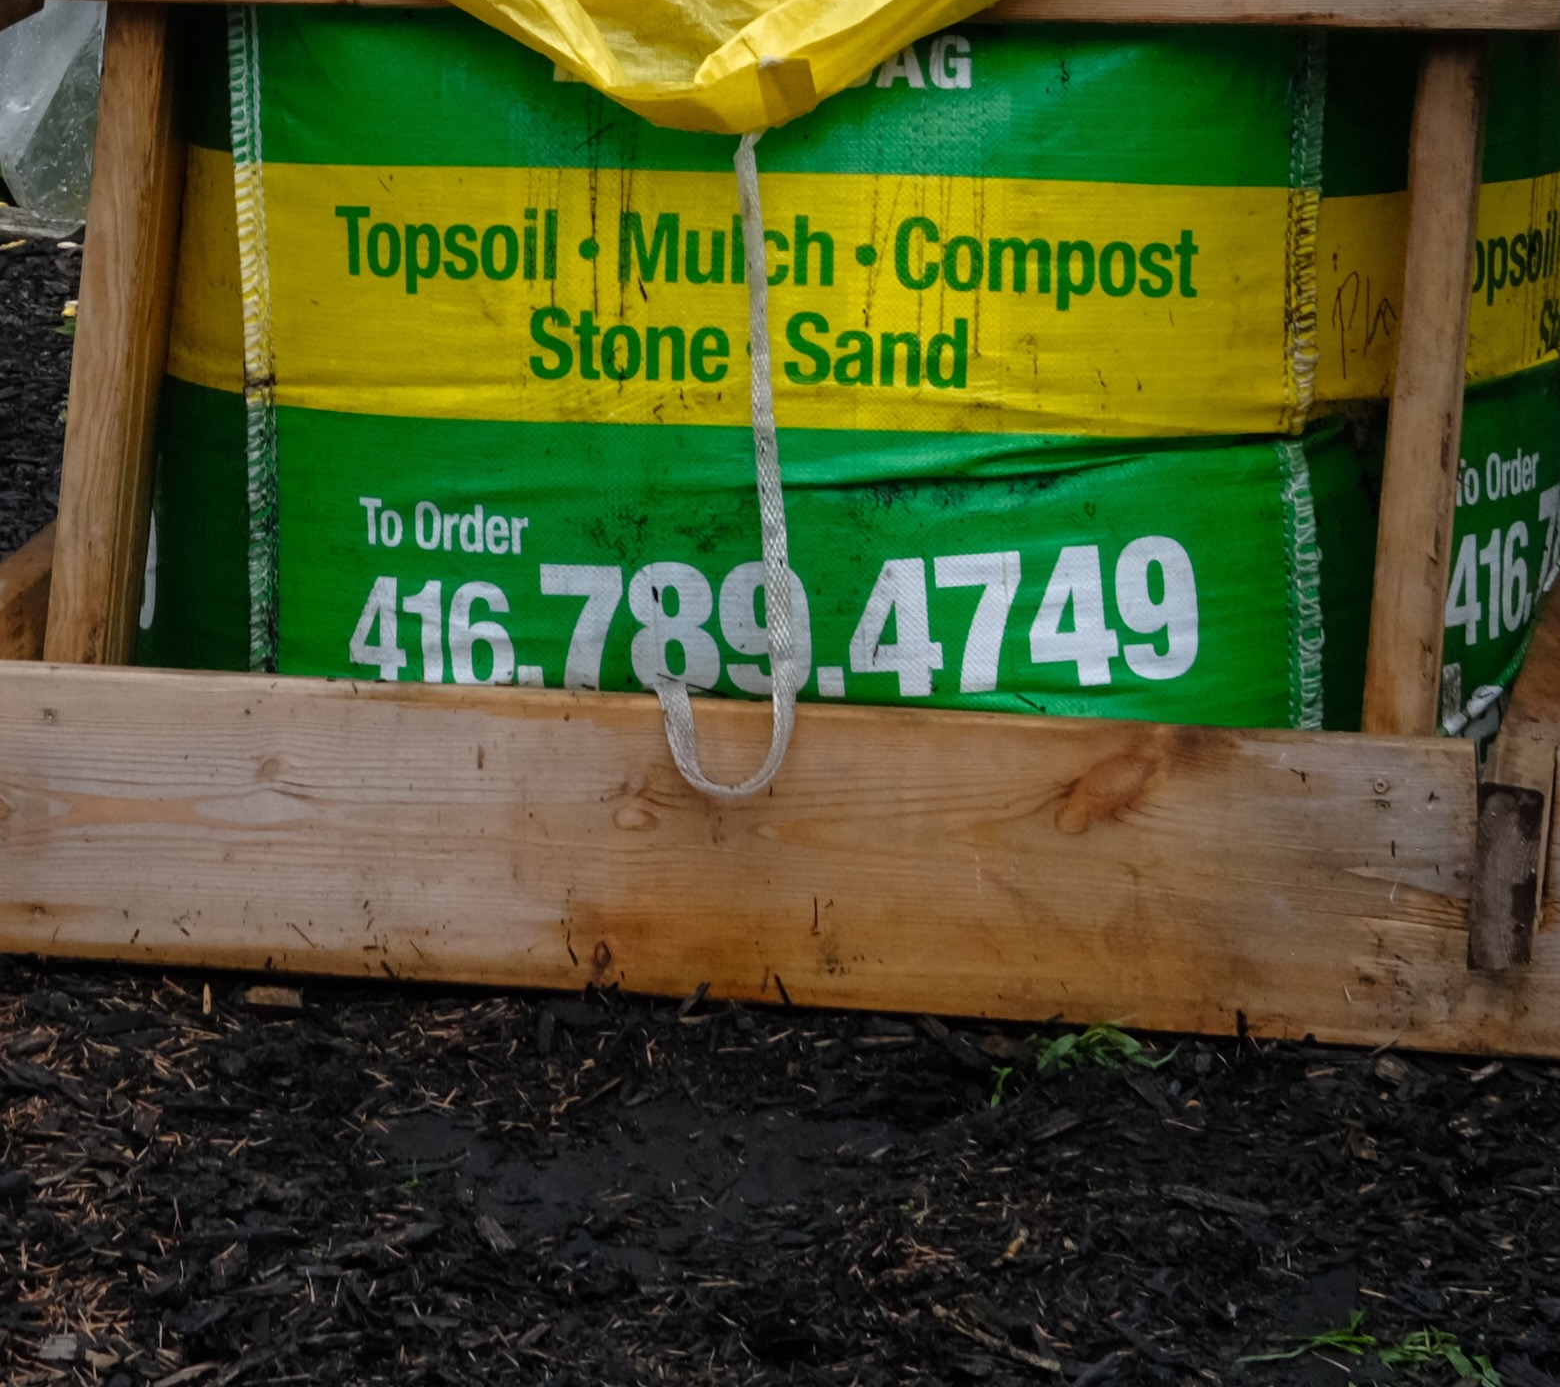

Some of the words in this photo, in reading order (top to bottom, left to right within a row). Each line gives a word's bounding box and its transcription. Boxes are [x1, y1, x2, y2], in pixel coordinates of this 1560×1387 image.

[850, 34, 974, 90] AG
[335, 204, 559, 295] Topsoil
[618, 210, 835, 287] Mulch
[894, 215, 1200, 312] Compost
[528, 305, 731, 383] Stone
[782, 310, 969, 390] Sand
[1485, 447, 1541, 503] Order
[359, 496, 403, 546] To
[414, 500, 528, 555] Order
[348, 535, 1199, 698] 416.789.4749
